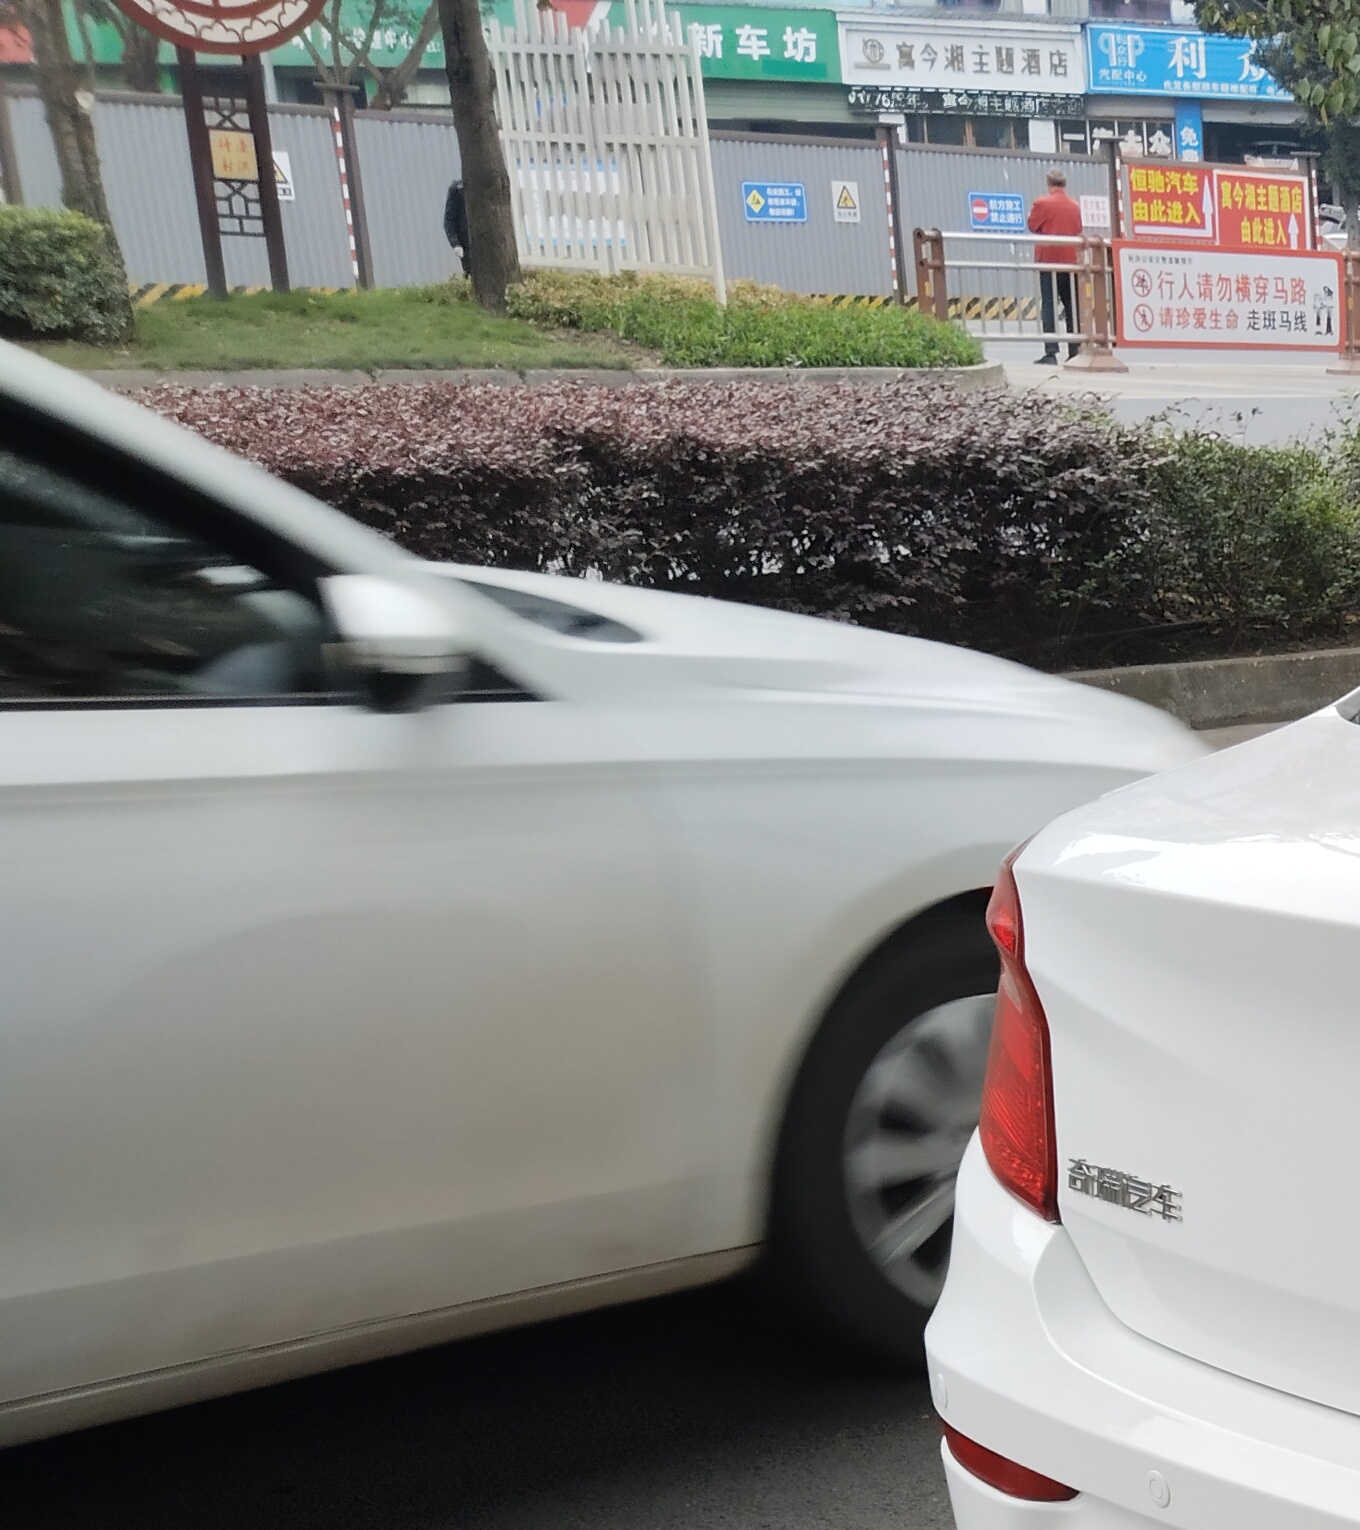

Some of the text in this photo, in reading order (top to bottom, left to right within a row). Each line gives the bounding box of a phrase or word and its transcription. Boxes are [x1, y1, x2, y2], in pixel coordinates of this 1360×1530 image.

[640, 21, 818, 63] 新车坊
[896, 41, 1068, 78] 寓今湘主题酒店
[1099, 68, 1147, 82] 汽配中心
[1130, 167, 1199, 195] 恒驰汽车
[1132, 199, 1201, 225] 由此进入
[1240, 217, 1288, 246] 由此进入
[1157, 270, 1307, 306] 行人请勿横穿马路
[1159, 306, 1240, 331] 请珍爱生命
[1067, 1158, 1183, 1222] 奇瑞汽车
